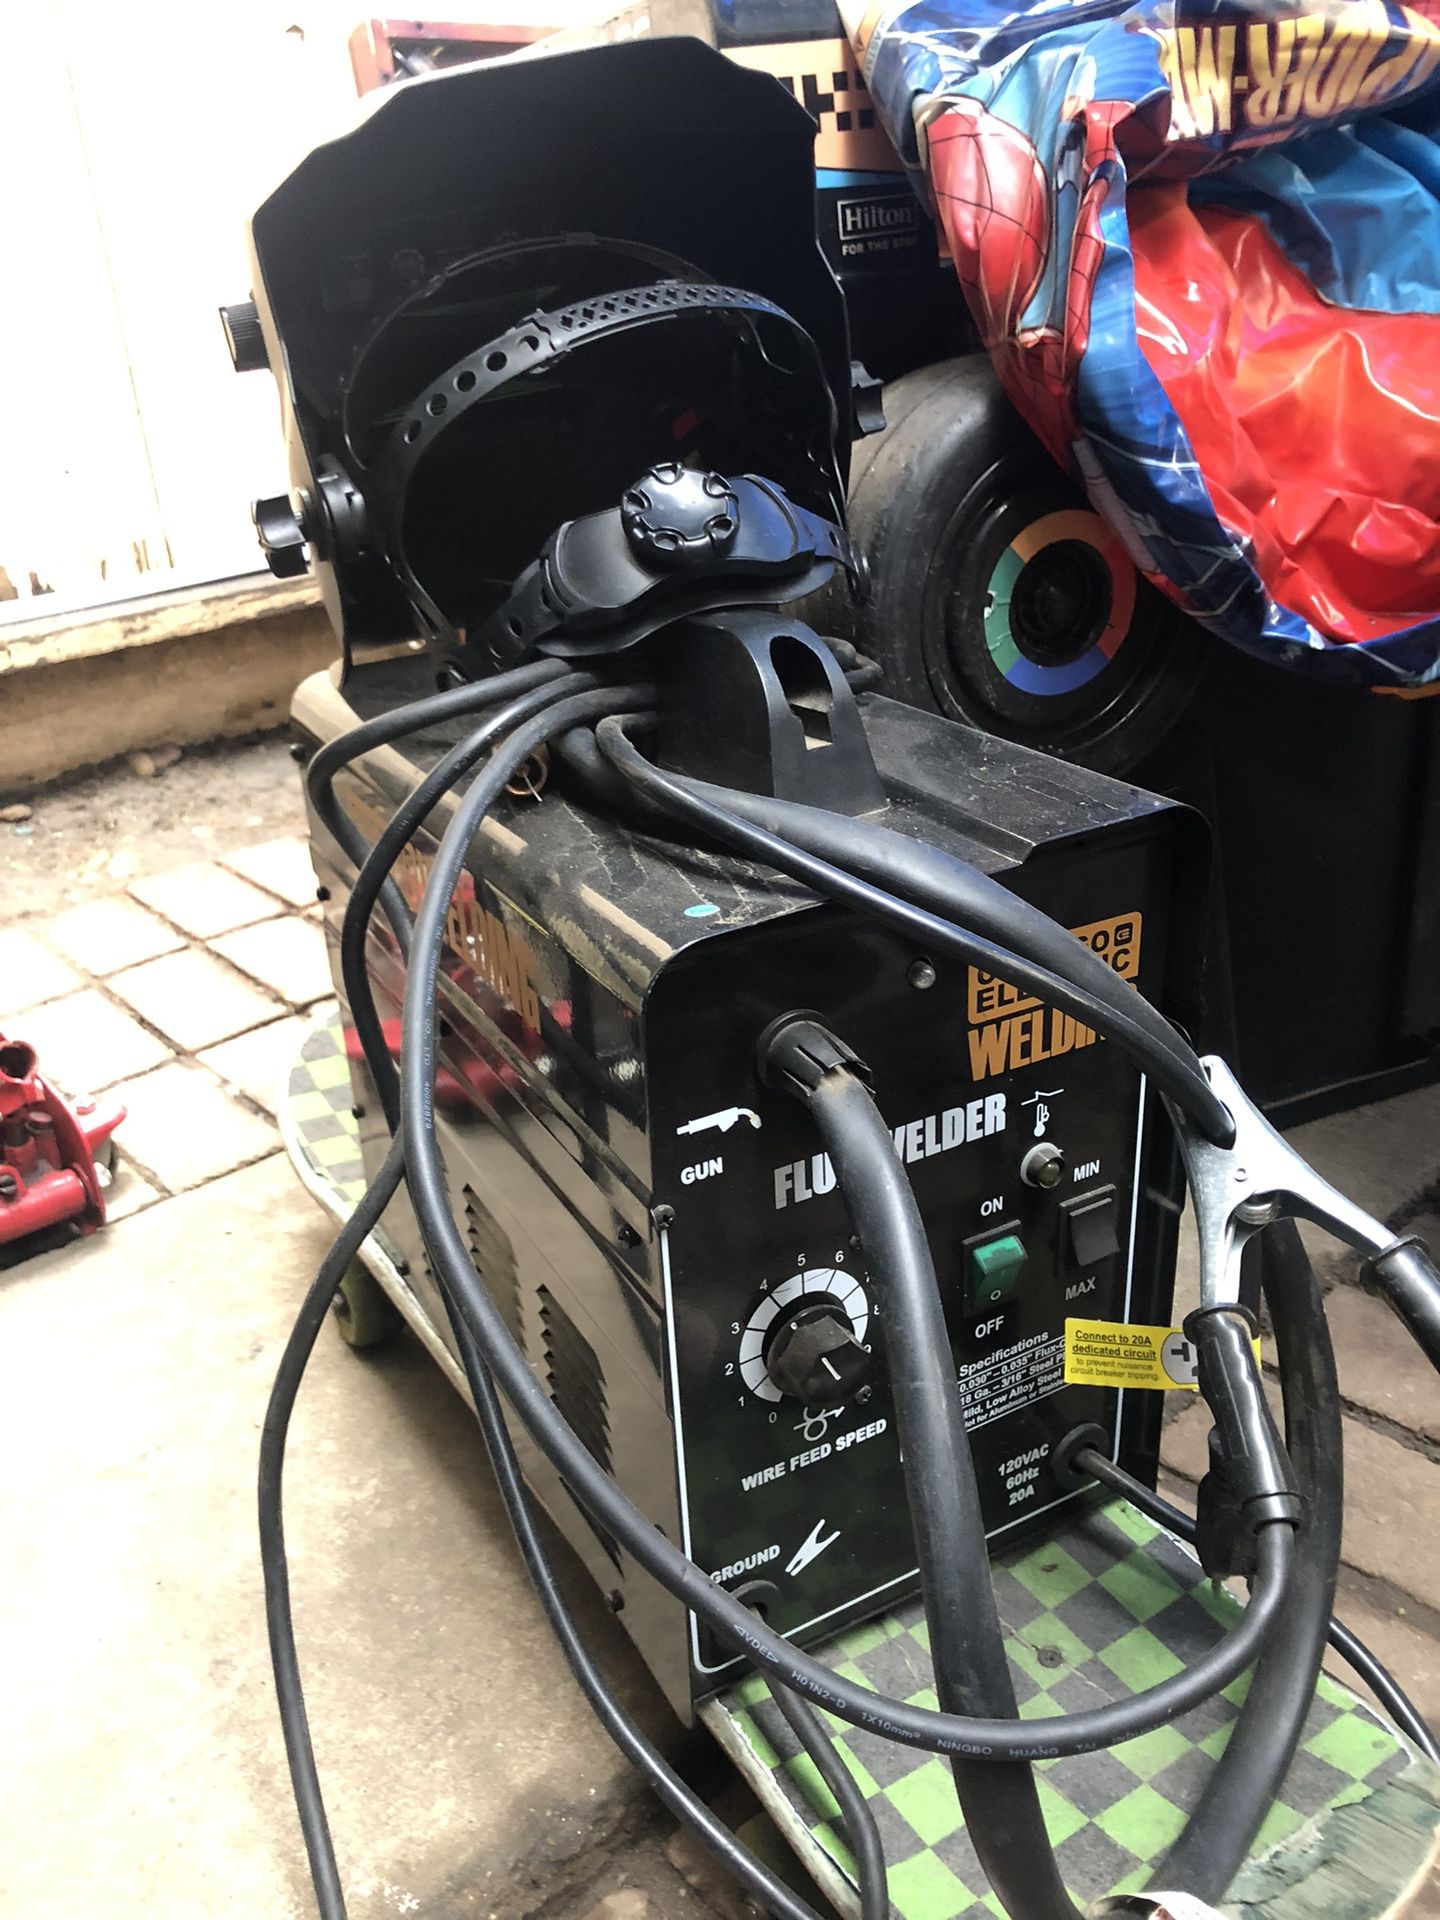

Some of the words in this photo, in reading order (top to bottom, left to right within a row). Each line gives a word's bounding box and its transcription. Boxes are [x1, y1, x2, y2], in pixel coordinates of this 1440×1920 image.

[845, 206, 912, 231] Hilton
[842, 242, 864, 256] FOR
[680, 1157, 723, 1185] GUN
[1073, 1160, 1100, 1182] MIN
[980, 1196, 1004, 1217] ON
[797, 1253, 806, 1267] 5
[835, 1250, 844, 1263] 6
[759, 1278, 769, 1291] 4
[1065, 1276, 1096, 1301] MAX
[731, 1321, 741, 1335] 3
[974, 1315, 1005, 1339] OFF
[1075, 1330, 1116, 1343] Connect
[1118, 1334, 1129, 1344] to
[1132, 1335, 1152, 1346] 20A
[959, 1331, 1049, 1377] Specifications
[1072, 1343, 1121, 1357] dedicated
[1123, 1348, 1157, 1361] circuit
[724, 1362, 734, 1376] 2
[1069, 1366, 1094, 1376] circuit
[1095, 1368, 1126, 1379] breaker
[1127, 1370, 1159, 1382] tripping
[1076, 1357, 1085, 1366] to
[1086, 1358, 1115, 1370] prevent
[1116, 1361, 1154, 1372] nuisance
[960, 1396, 972, 1406] 18
[974, 1388, 991, 1400] Ga.
[1001, 1369, 1027, 1388] 3/16"
[1029, 1356, 1054, 1375] Steel
[986, 1392, 1008, 1409] Low
[1009, 1381, 1035, 1400] Alloy
[1036, 1367, 1062, 1386] Steel
[738, 1395, 745, 1407] 1
[976, 1414, 988, 1423] for
[989, 1395, 1028, 1418] Aluminum
[1029, 1391, 1037, 1399] or
[768, 1411, 777, 1424] 0
[740, 1461, 786, 1492] WIRE
[789, 1442, 833, 1472] FEED
[835, 1418, 888, 1451] SPEED
[998, 1443, 1049, 1476] 120VAC
[1006, 1467, 1040, 1490] 60Hz
[1008, 1484, 1035, 1506] 20A
[709, 1545, 781, 1584] GROUND
[791, 1670, 847, 1710] H01N2-D
[937, 1738, 993, 1756] NINGBO
[1009, 1744, 1060, 1758] HUANG
